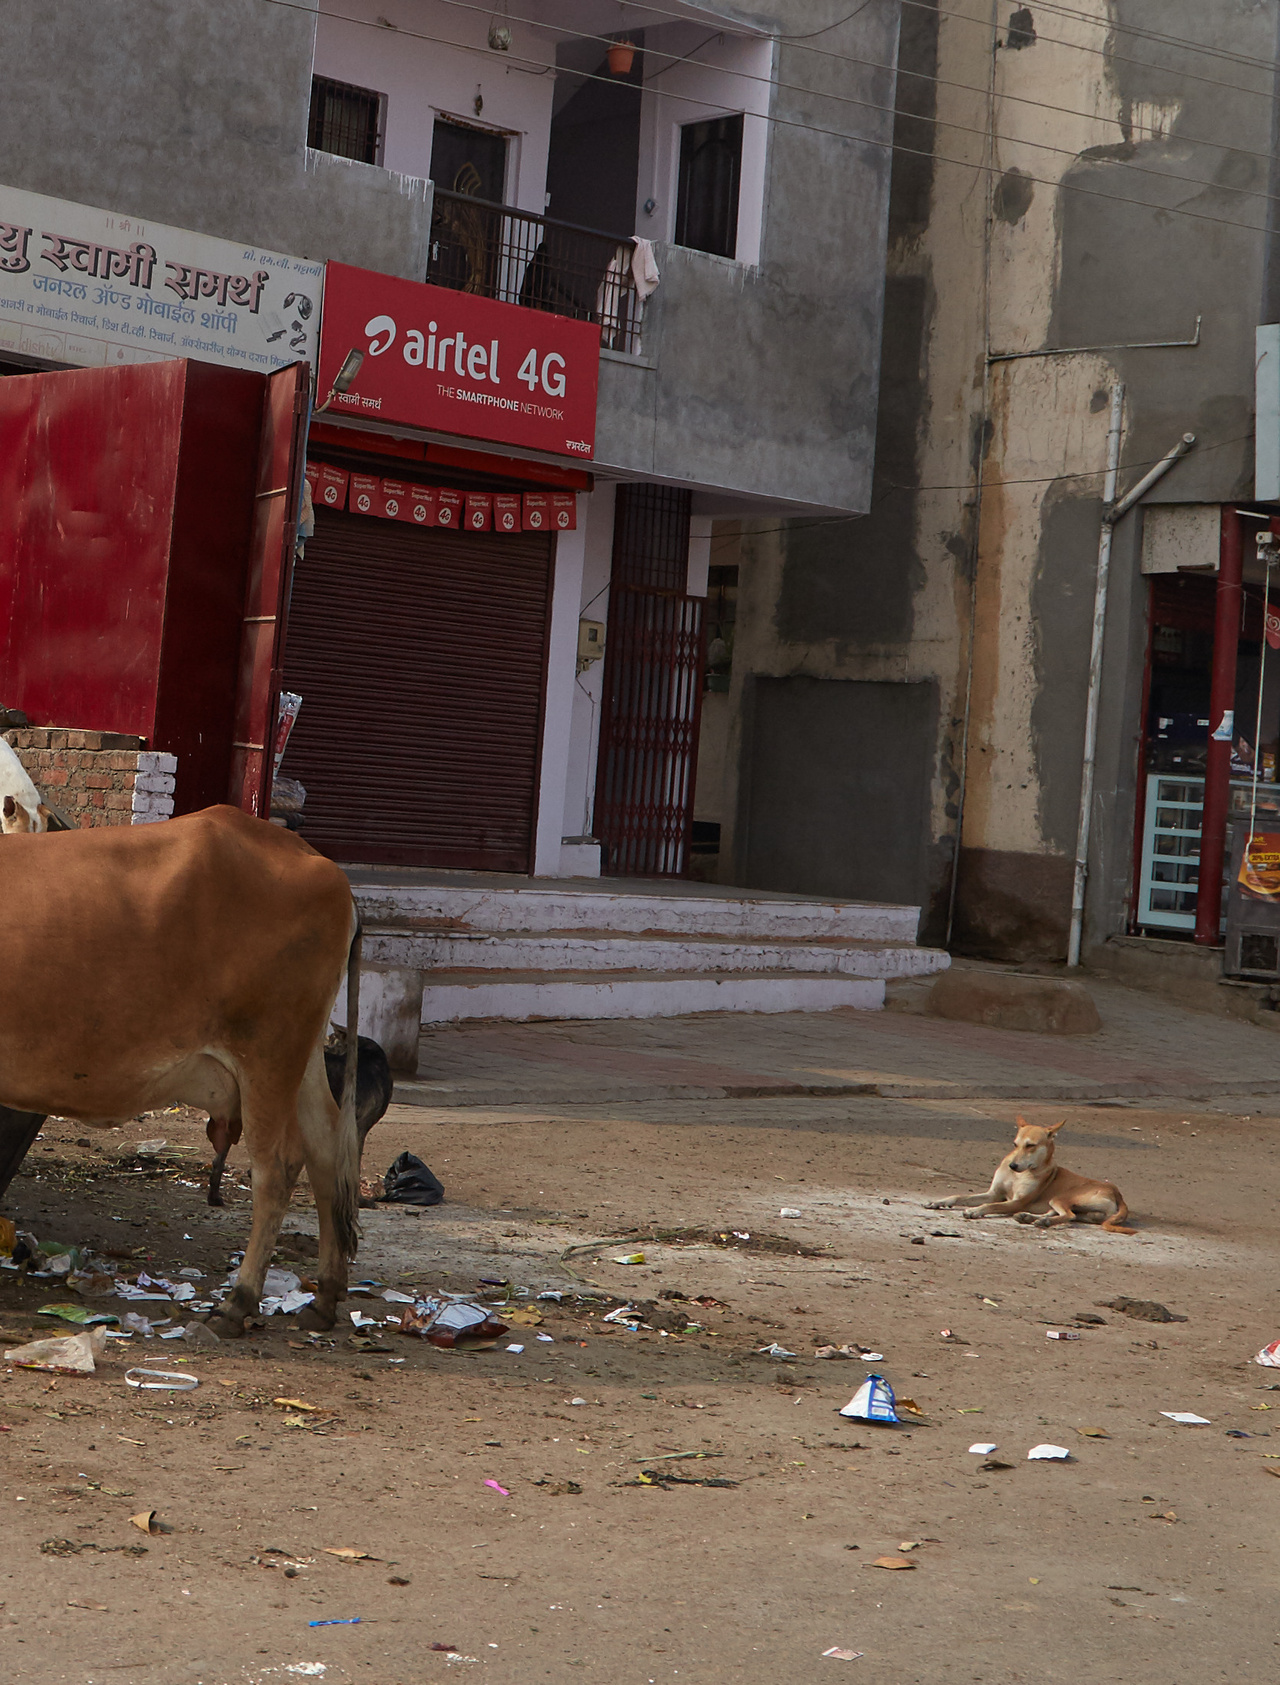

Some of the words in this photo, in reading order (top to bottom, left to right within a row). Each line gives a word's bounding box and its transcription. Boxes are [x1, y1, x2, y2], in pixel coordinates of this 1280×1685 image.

[119, 219, 131, 232] श्री
[32, 273, 88, 300] जनरल
[136, 293, 196, 325] मोबाईल
[200, 309, 238, 334] शॉपी
[40, 231, 157, 290] स्वामी
[164, 260, 270, 315] समर्थ
[27, 304, 33, 314] व
[36, 303, 68, 321] मोबाईल
[70, 311, 99, 330] रिचार्ज,
[102, 318, 119, 332] डिश
[227, 345, 246, 359] योग्य
[248, 351, 268, 364] दरात
[403, 320, 500, 384] airtel
[517, 348, 566, 398] 4G
[338, 392, 360, 406] स्वामी
[361, 397, 382, 410] समर्थ
[437, 384, 455, 399] THE
[456, 388, 519, 412] SMARTPHONE
[520, 402, 564, 421] NETWORK
